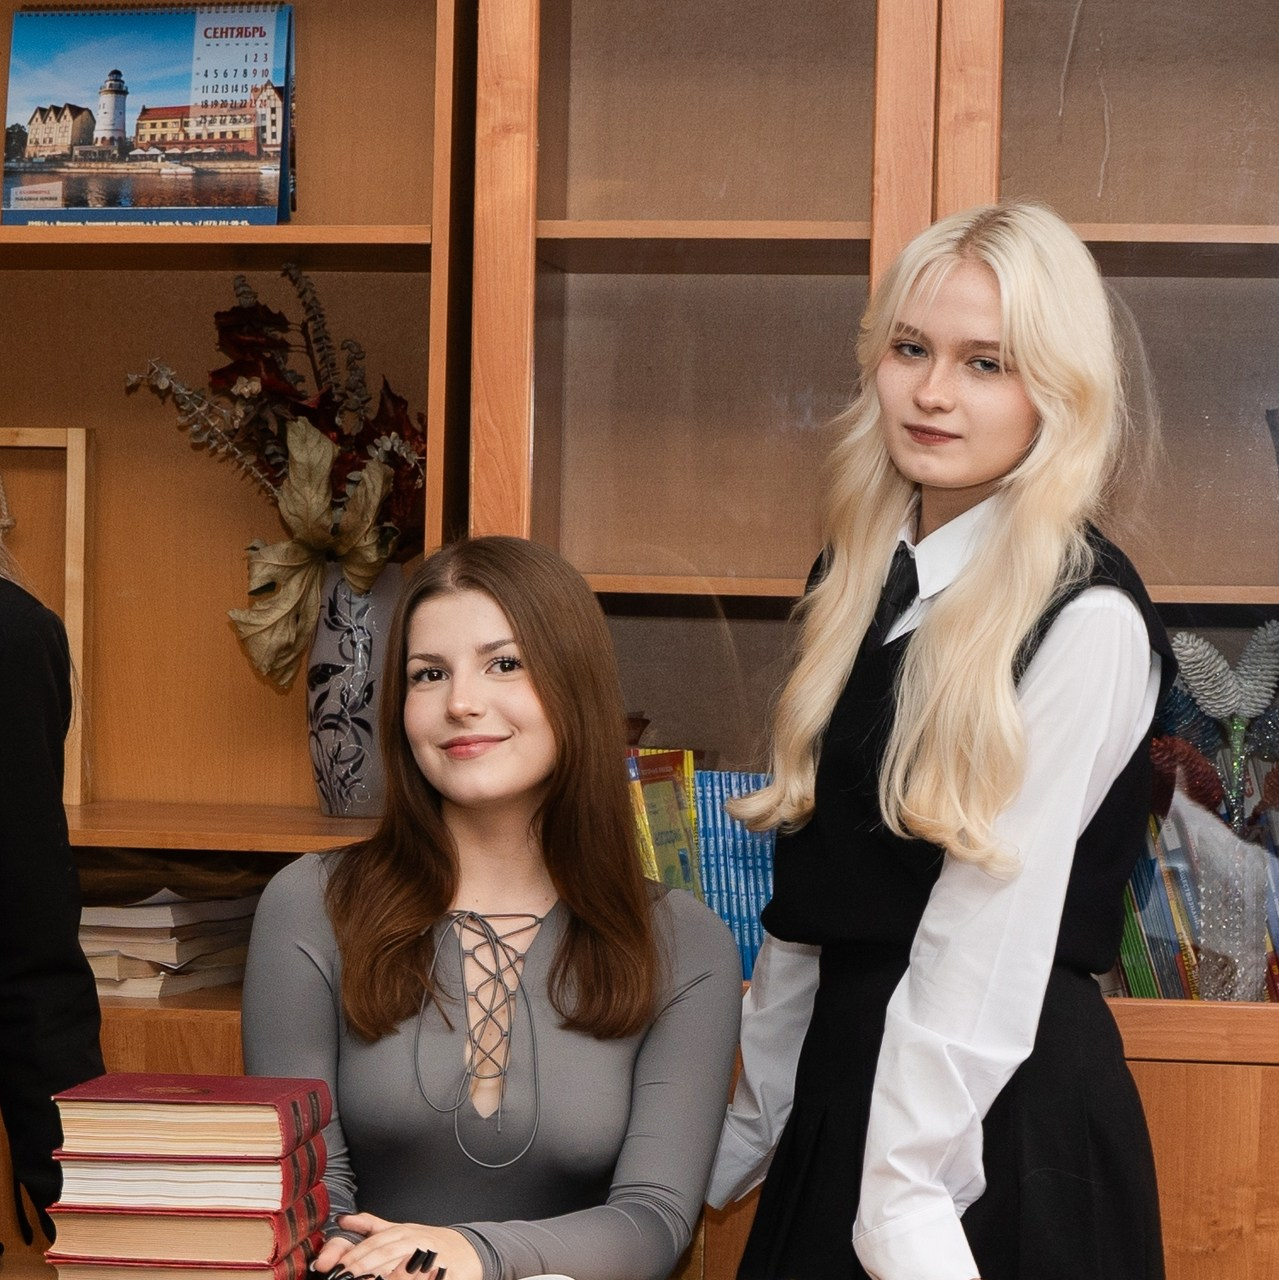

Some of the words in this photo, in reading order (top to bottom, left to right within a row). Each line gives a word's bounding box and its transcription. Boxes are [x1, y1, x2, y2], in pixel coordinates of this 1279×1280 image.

[204, 26, 266, 38] СЕНТЯБРЬ
[244, 54, 247, 62] 1
[254, 54, 258, 62] 2
[264, 54, 267, 62] 3
[204, 69, 208, 78] 4
[214, 69, 218, 78] 5
[223, 69, 228, 78] 6
[233, 69, 238, 78] 7
[243, 69, 247, 78] 8
[252, 69, 257, 77] 9
[261, 69, 269, 77] 10
[202, 85, 208, 93] 11
[212, 85, 218, 93] 12
[221, 85, 228, 93] 13
[231, 85, 238, 93] 14
[241, 85, 248, 93] 15
[201, 100, 208, 108] 18
[211, 100, 218, 108] 19
[220, 100, 227, 108] 20
[230, 99, 237, 108] 21
[239, 99, 247, 108] 22
